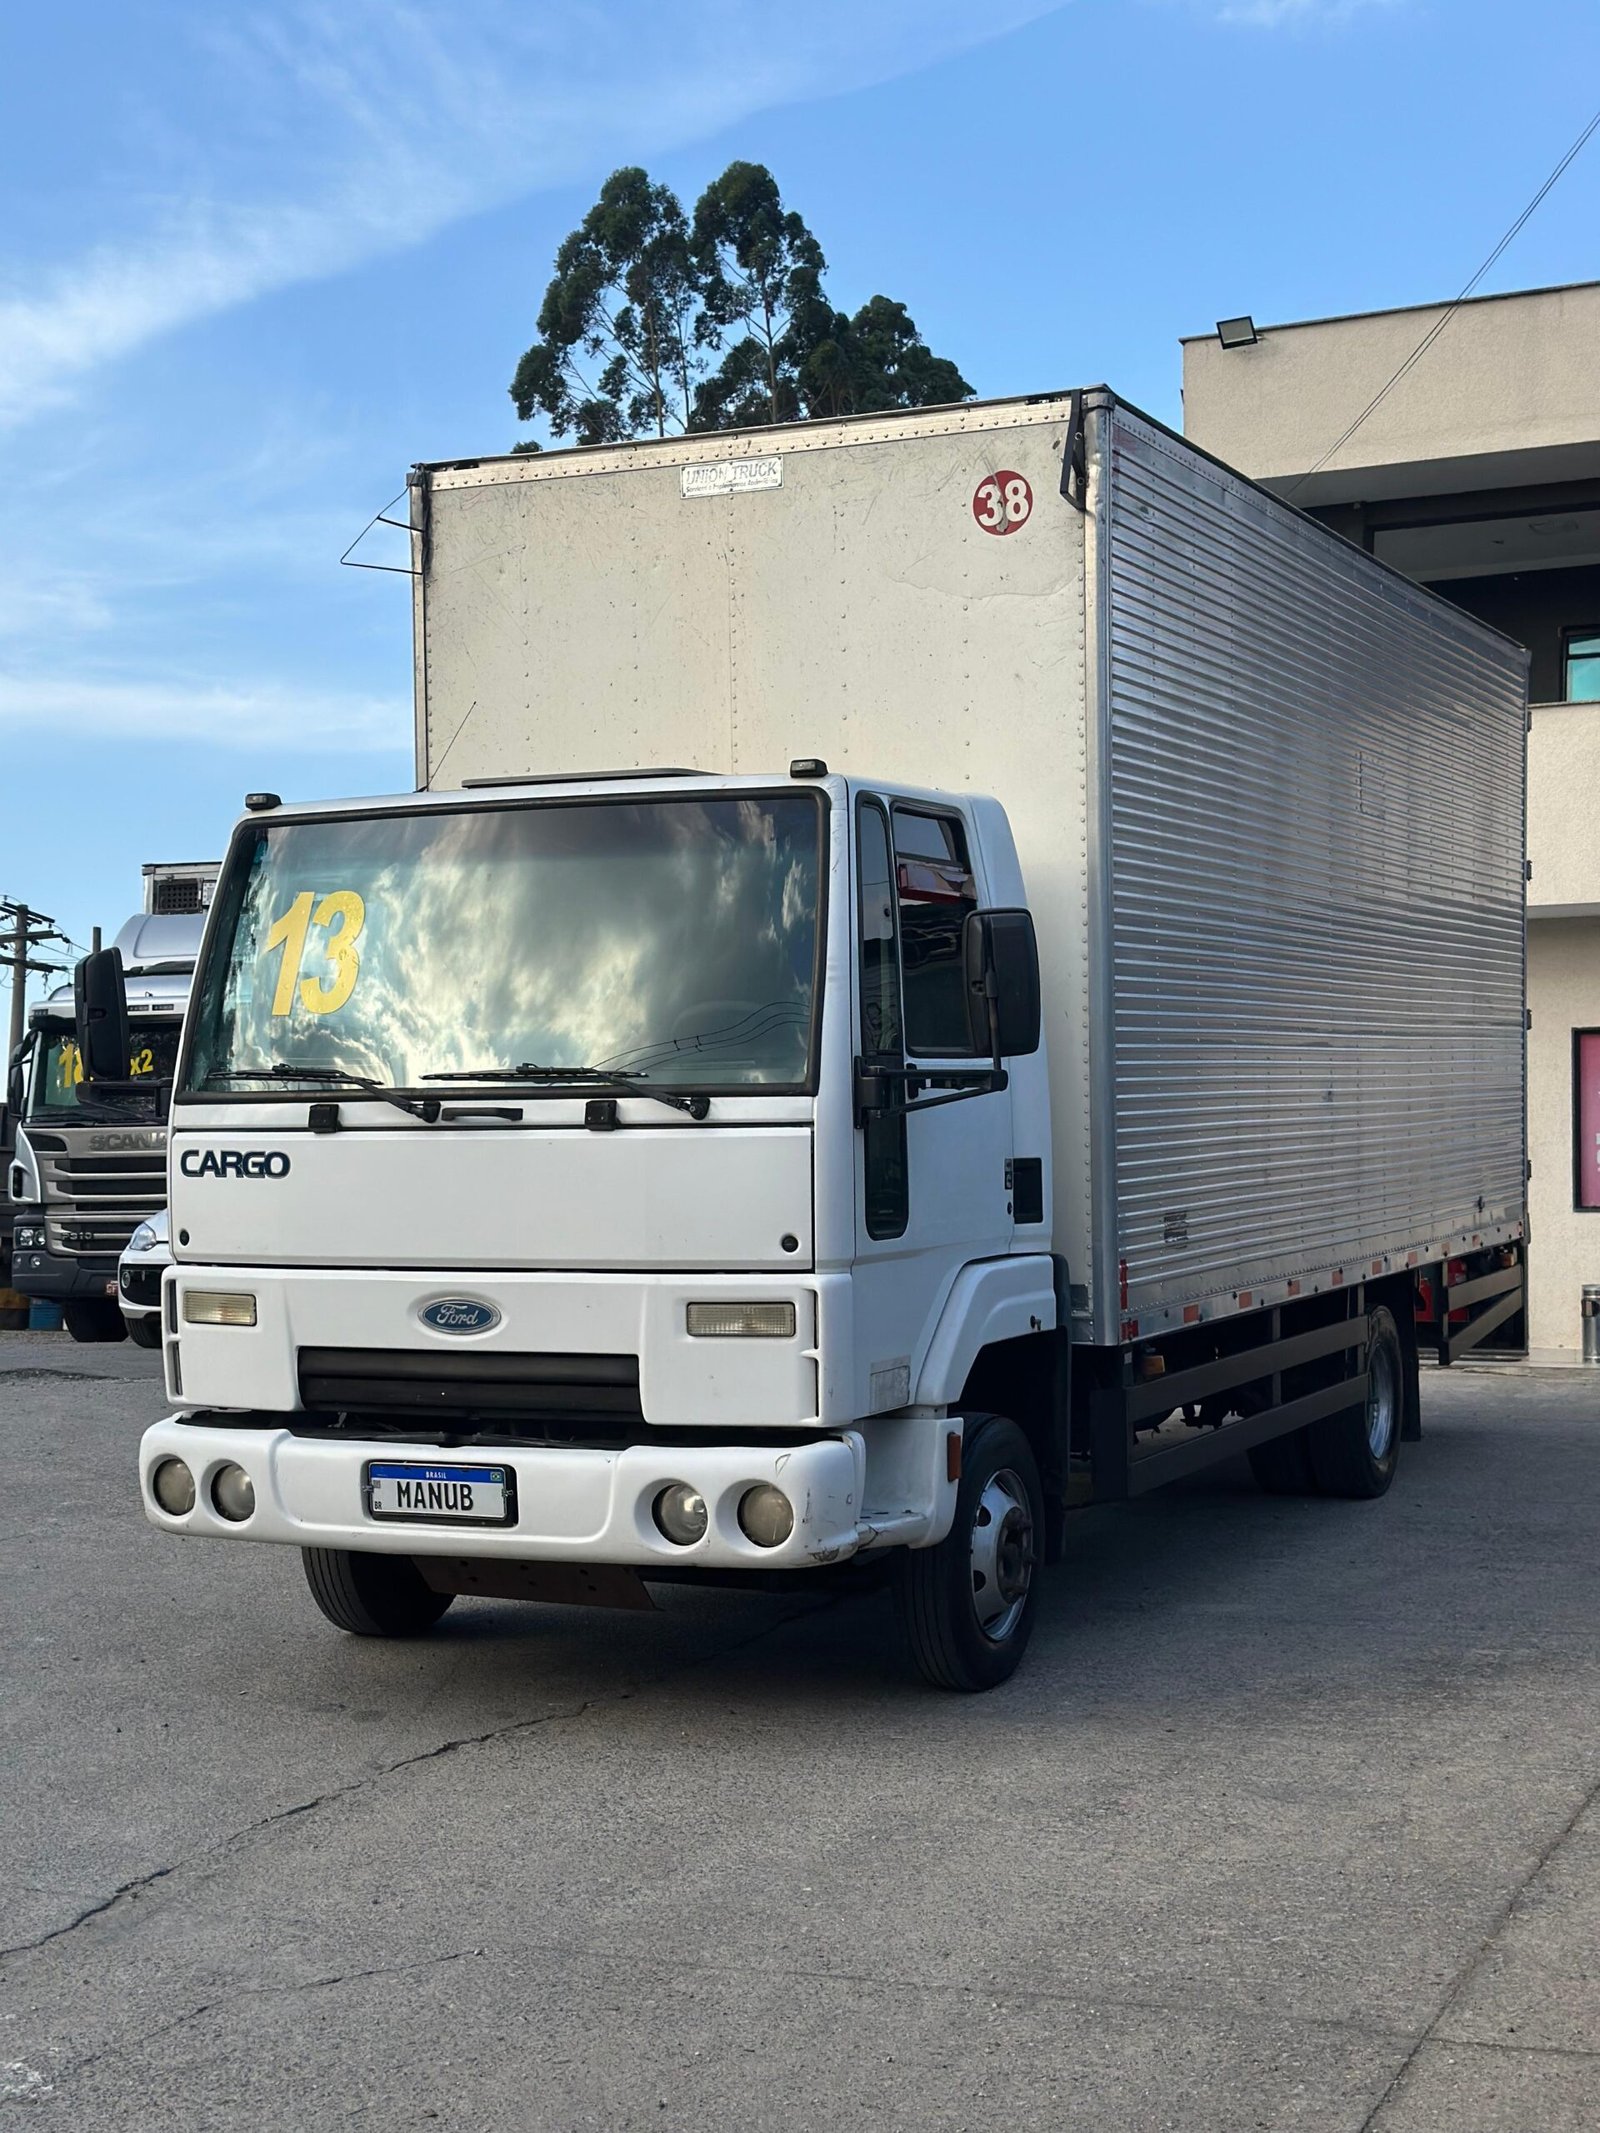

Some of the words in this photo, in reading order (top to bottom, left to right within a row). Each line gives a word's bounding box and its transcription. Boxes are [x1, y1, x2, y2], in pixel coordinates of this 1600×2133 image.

[732, 461, 777, 480] TRUCK
[977, 479, 1030, 527] 38
[262, 890, 366, 1016] 13
[180, 1149, 292, 1179] CARGO
[436, 1303, 479, 1325] Ford
[425, 1471, 447, 1479] BRASIL
[374, 1500, 382, 1510] BR
[396, 1480, 474, 1511] MANUB
